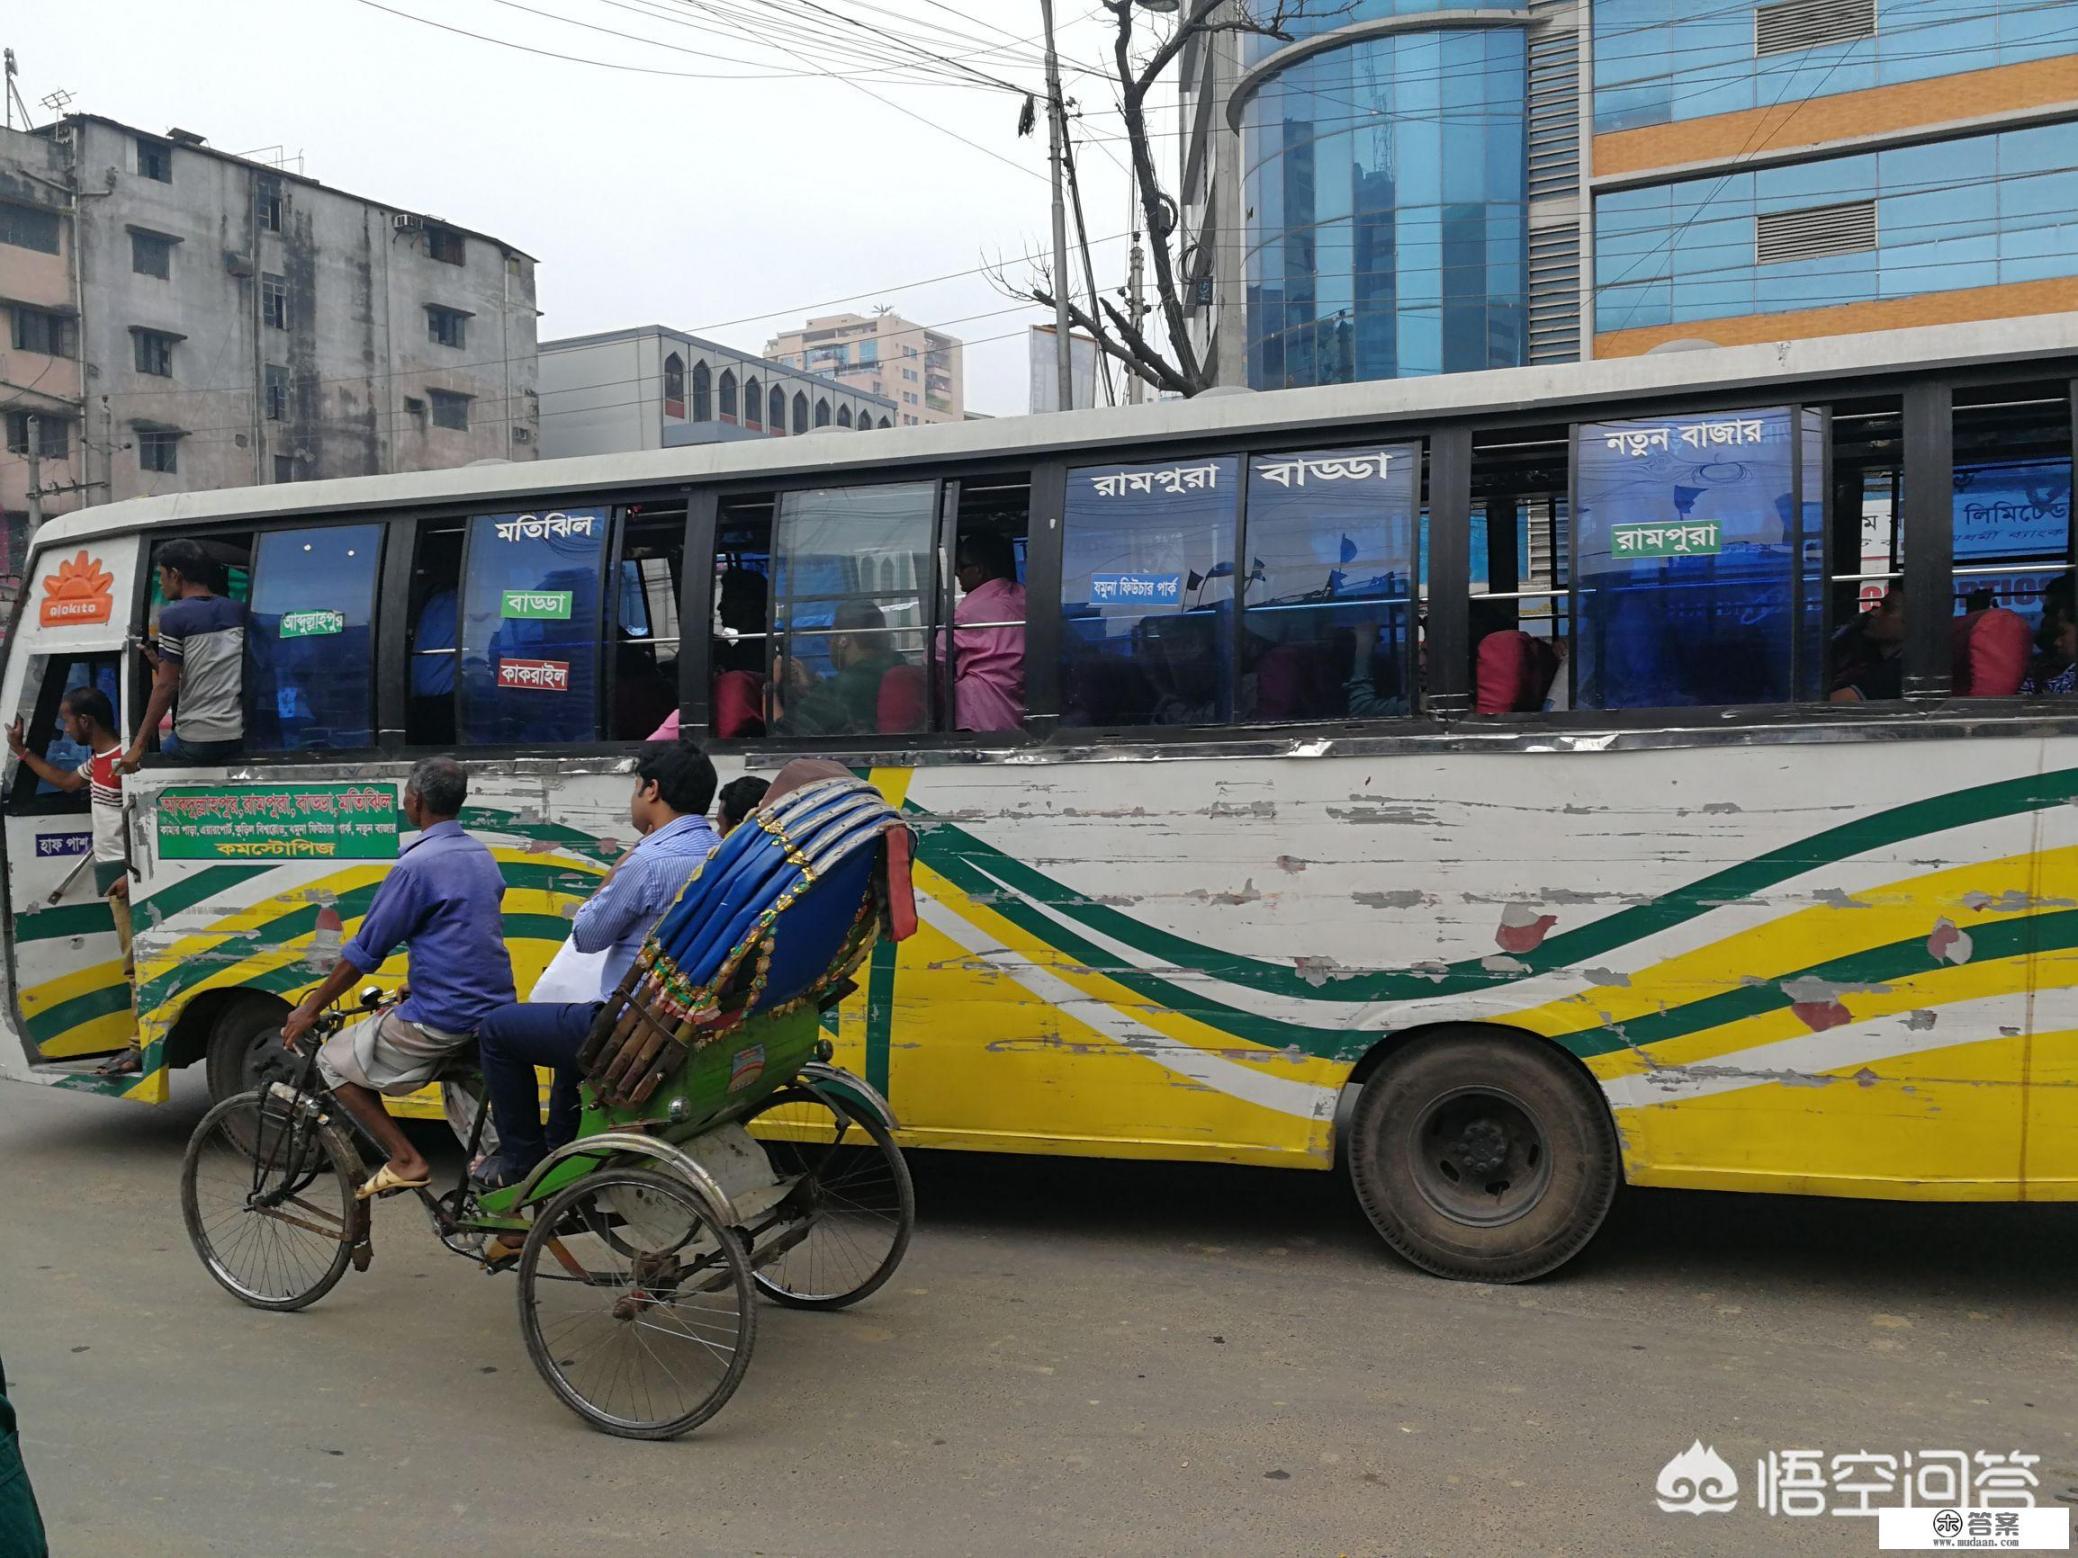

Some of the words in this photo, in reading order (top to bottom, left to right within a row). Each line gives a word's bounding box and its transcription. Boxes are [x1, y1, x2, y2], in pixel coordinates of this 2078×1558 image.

[1604, 428, 1670, 457] নতুন
[1678, 418, 1764, 448] বাজার
[1090, 464, 1220, 496] রামপুরা
[1255, 452, 1393, 488] বাড্ডা
[495, 512, 595, 542] মতিঝিল
[1614, 524, 1718, 552] রামপুরা
[1094, 581, 1117, 599] যমুনা
[1119, 576, 1154, 597] ফিউচার
[1157, 576, 1179, 597] পার্ক
[506, 592, 566, 613] বাড্ডা
[501, 662, 567, 688] কাকরাইল
[336, 787, 393, 814] মতিঝিল
[38, 838, 63, 855] হাফ
